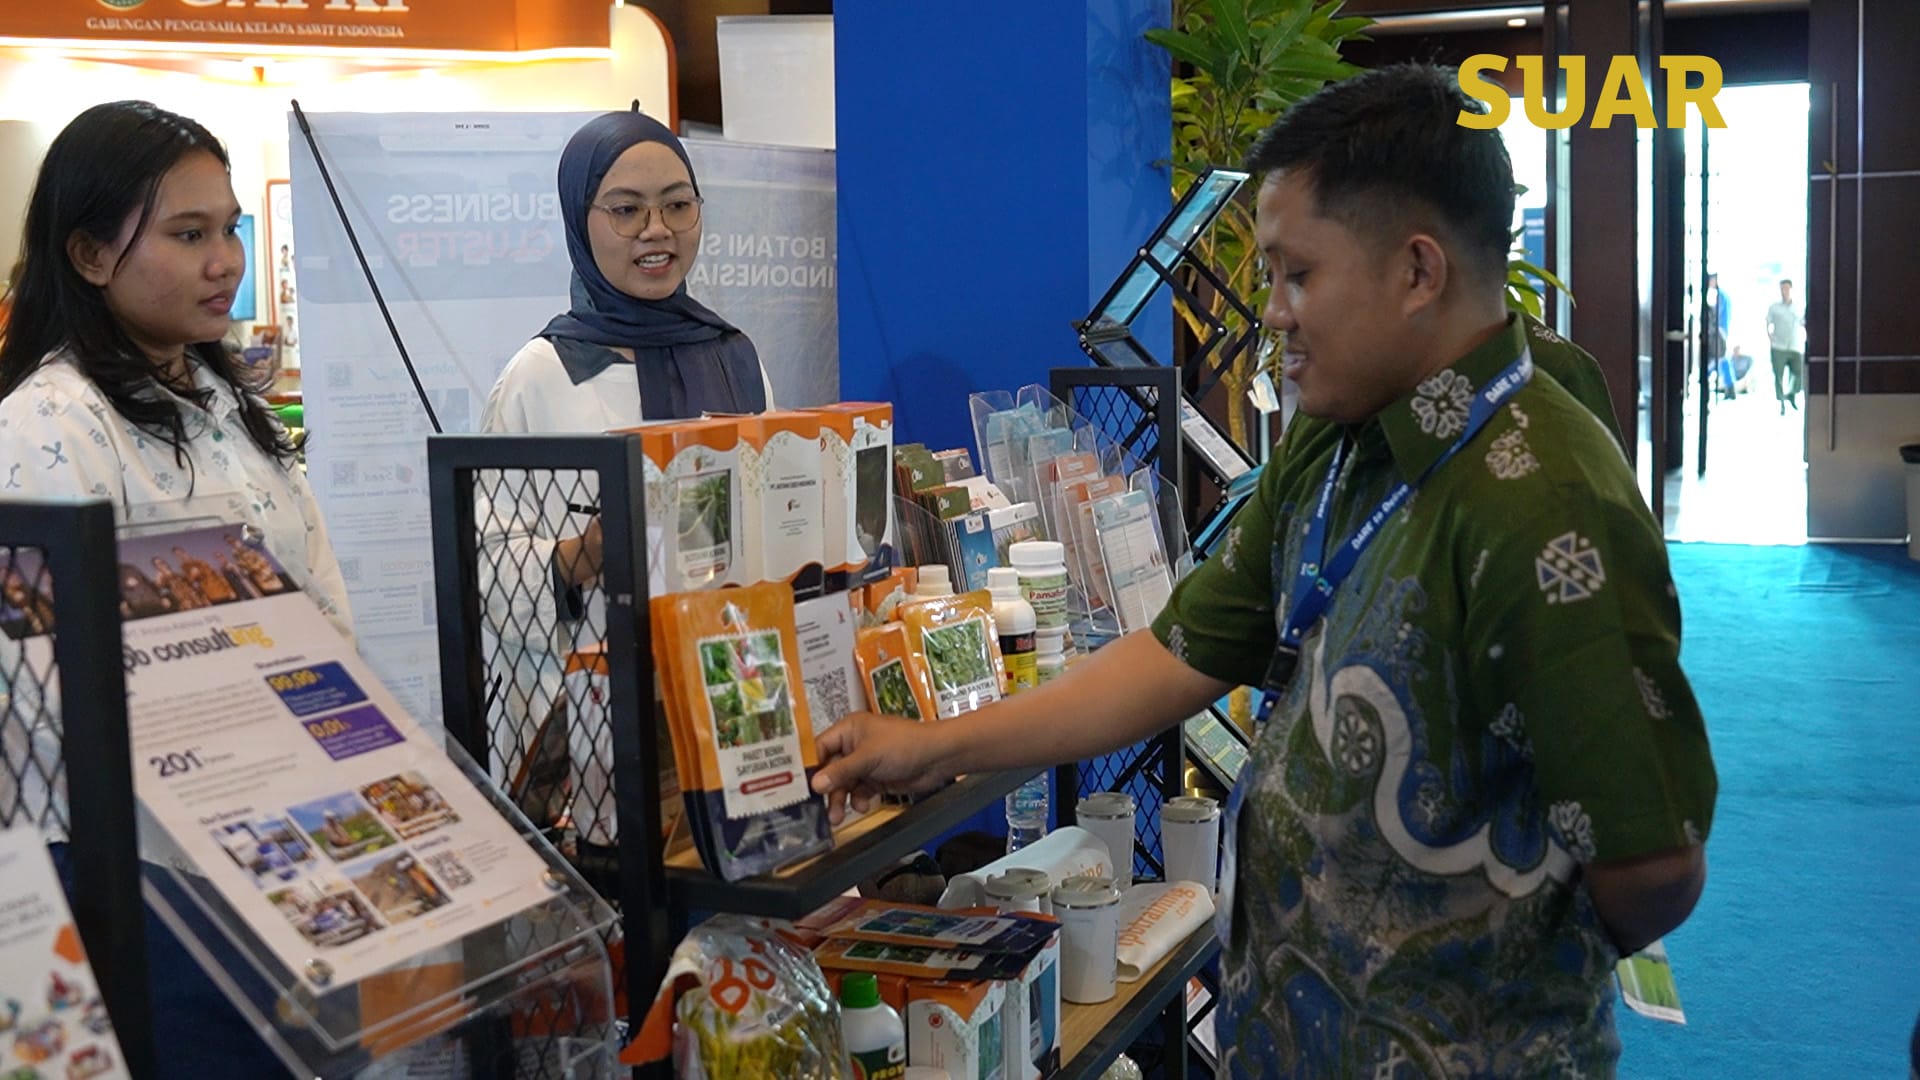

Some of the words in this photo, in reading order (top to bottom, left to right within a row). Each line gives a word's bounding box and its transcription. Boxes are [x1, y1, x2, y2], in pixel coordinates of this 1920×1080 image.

[86, 17, 162, 30] GABUNGAN
[164, 19, 243, 33] PENGUSAHA
[244, 22, 295, 34] KELAPA
[297, 23, 334, 36] SAWIT
[337, 25, 405, 38] INDONESIA
[153, 625, 274, 662] consulting
